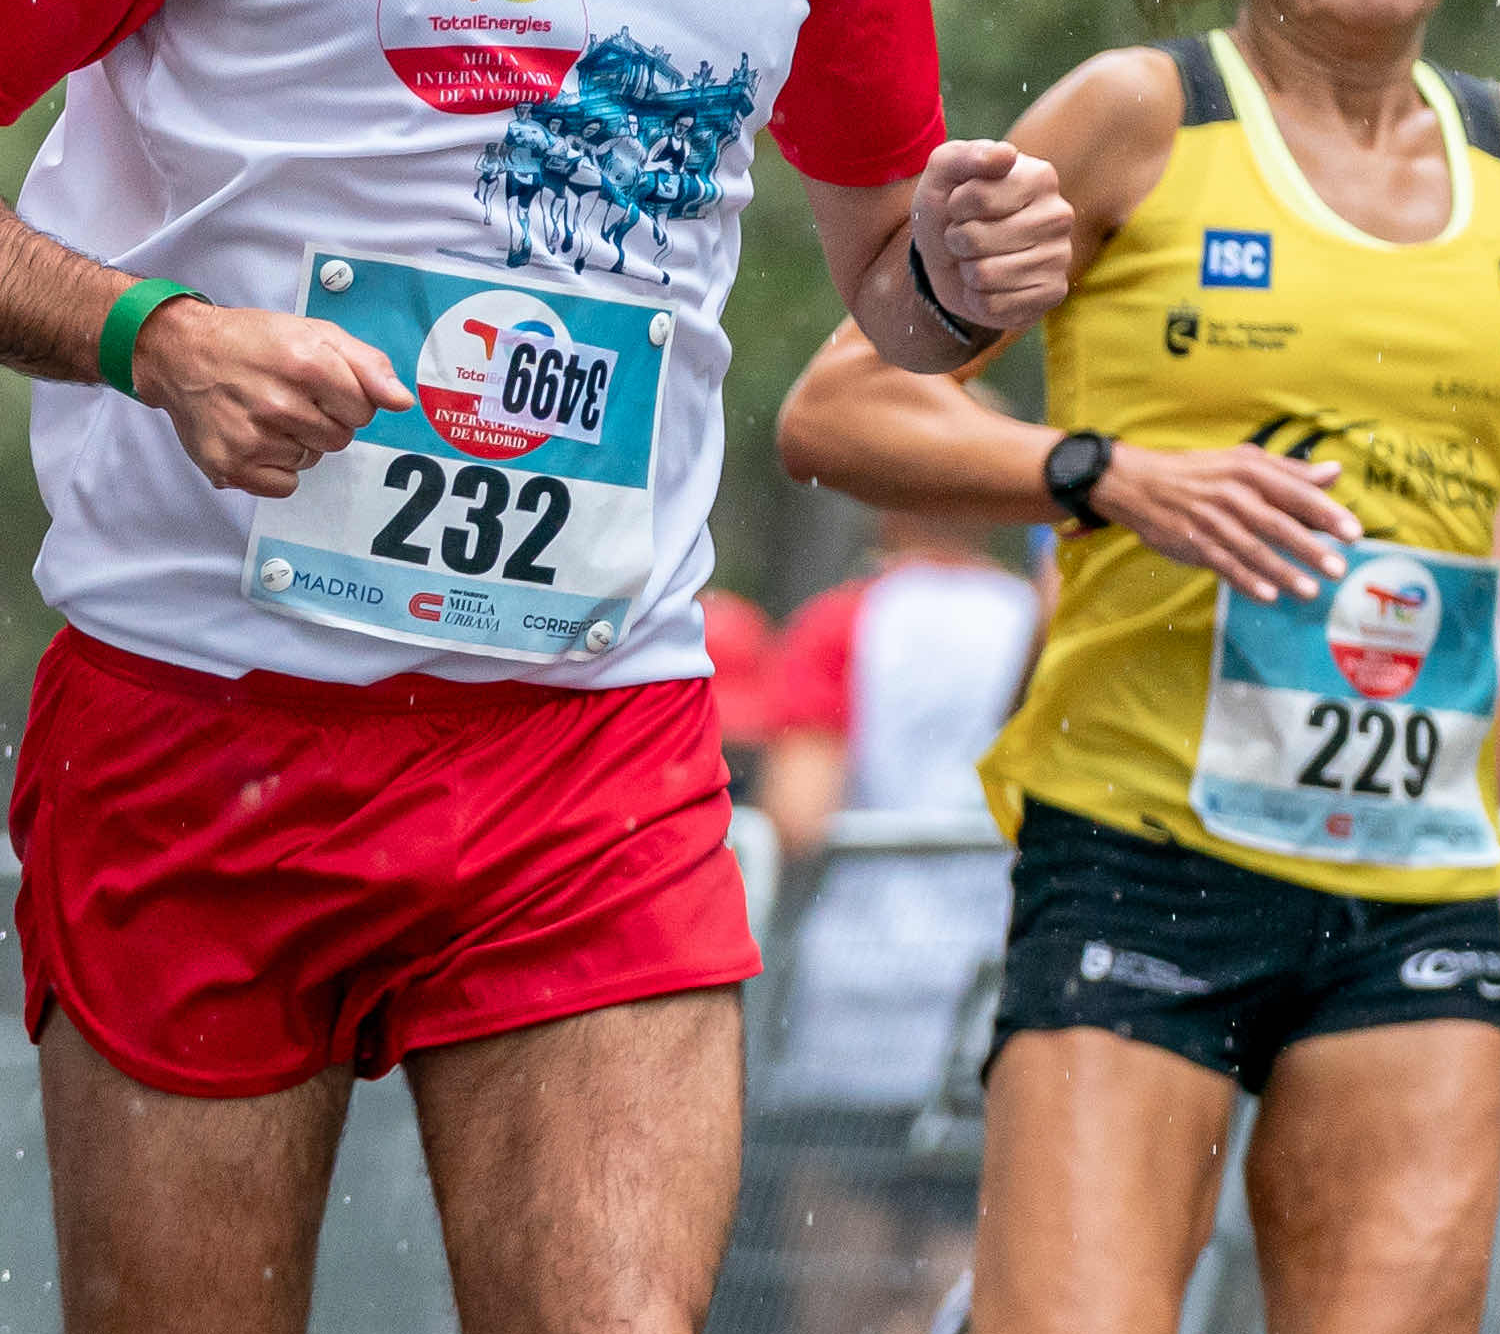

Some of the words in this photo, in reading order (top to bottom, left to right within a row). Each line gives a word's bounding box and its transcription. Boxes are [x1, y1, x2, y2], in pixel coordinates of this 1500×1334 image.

[428, 15, 552, 35] TotalEnergies
[439, 88, 465, 103] DE
[471, 87, 541, 103] MADRID
[1207, 239, 1267, 280] ISC
[450, 426, 470, 441] DE
[472, 430, 529, 450] MADRID
[370, 453, 572, 586] 232
[292, 570, 385, 606] MADRID
[447, 596, 496, 616] MILLA
[444, 610, 501, 633] URBANA
[1297, 701, 1441, 798] 229
